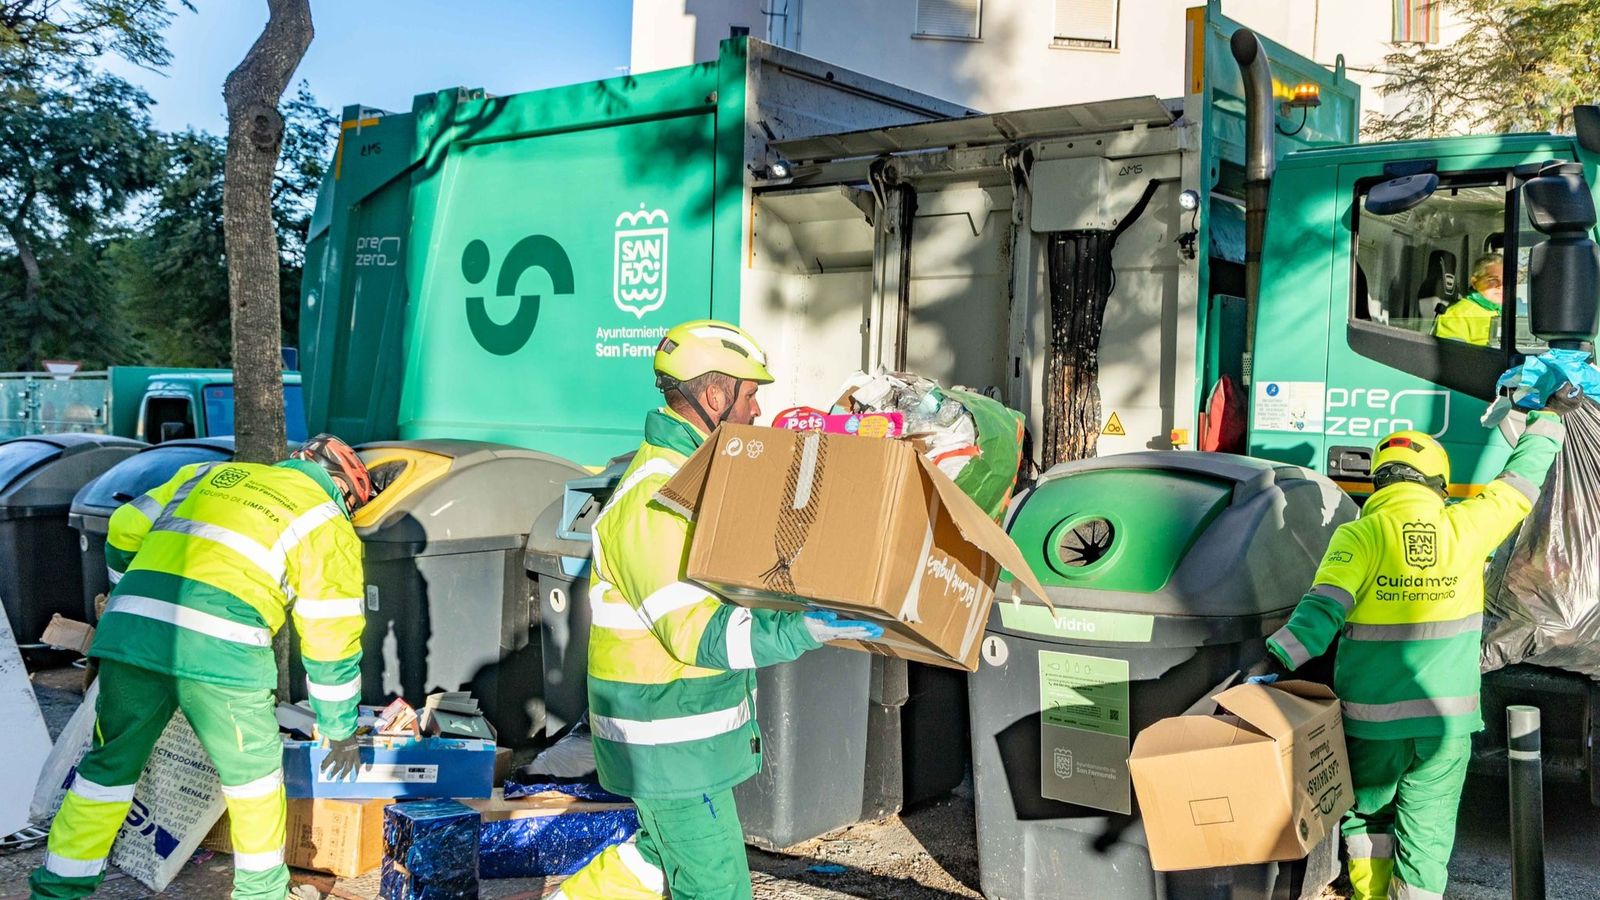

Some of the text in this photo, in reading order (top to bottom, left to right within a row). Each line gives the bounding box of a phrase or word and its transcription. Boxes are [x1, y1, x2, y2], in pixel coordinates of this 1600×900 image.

[356, 237, 379, 252] pre
[621, 239, 660, 262] SAN
[355, 254, 387, 266] zero
[595, 342, 620, 358] San
[1325, 387, 1390, 413] pre
[787, 416, 823, 430] Pets
[243, 482, 295, 511] San Fernando
[199, 488, 280, 523] EQUIPO DE LIMPIEZA
[1408, 534, 1432, 545] SAN
[1376, 574, 1458, 588] Cuidamos
[1376, 589, 1456, 602] San Fernando
[1053, 617, 1096, 632] Vidrio
[179, 785, 211, 802] MENAJE
